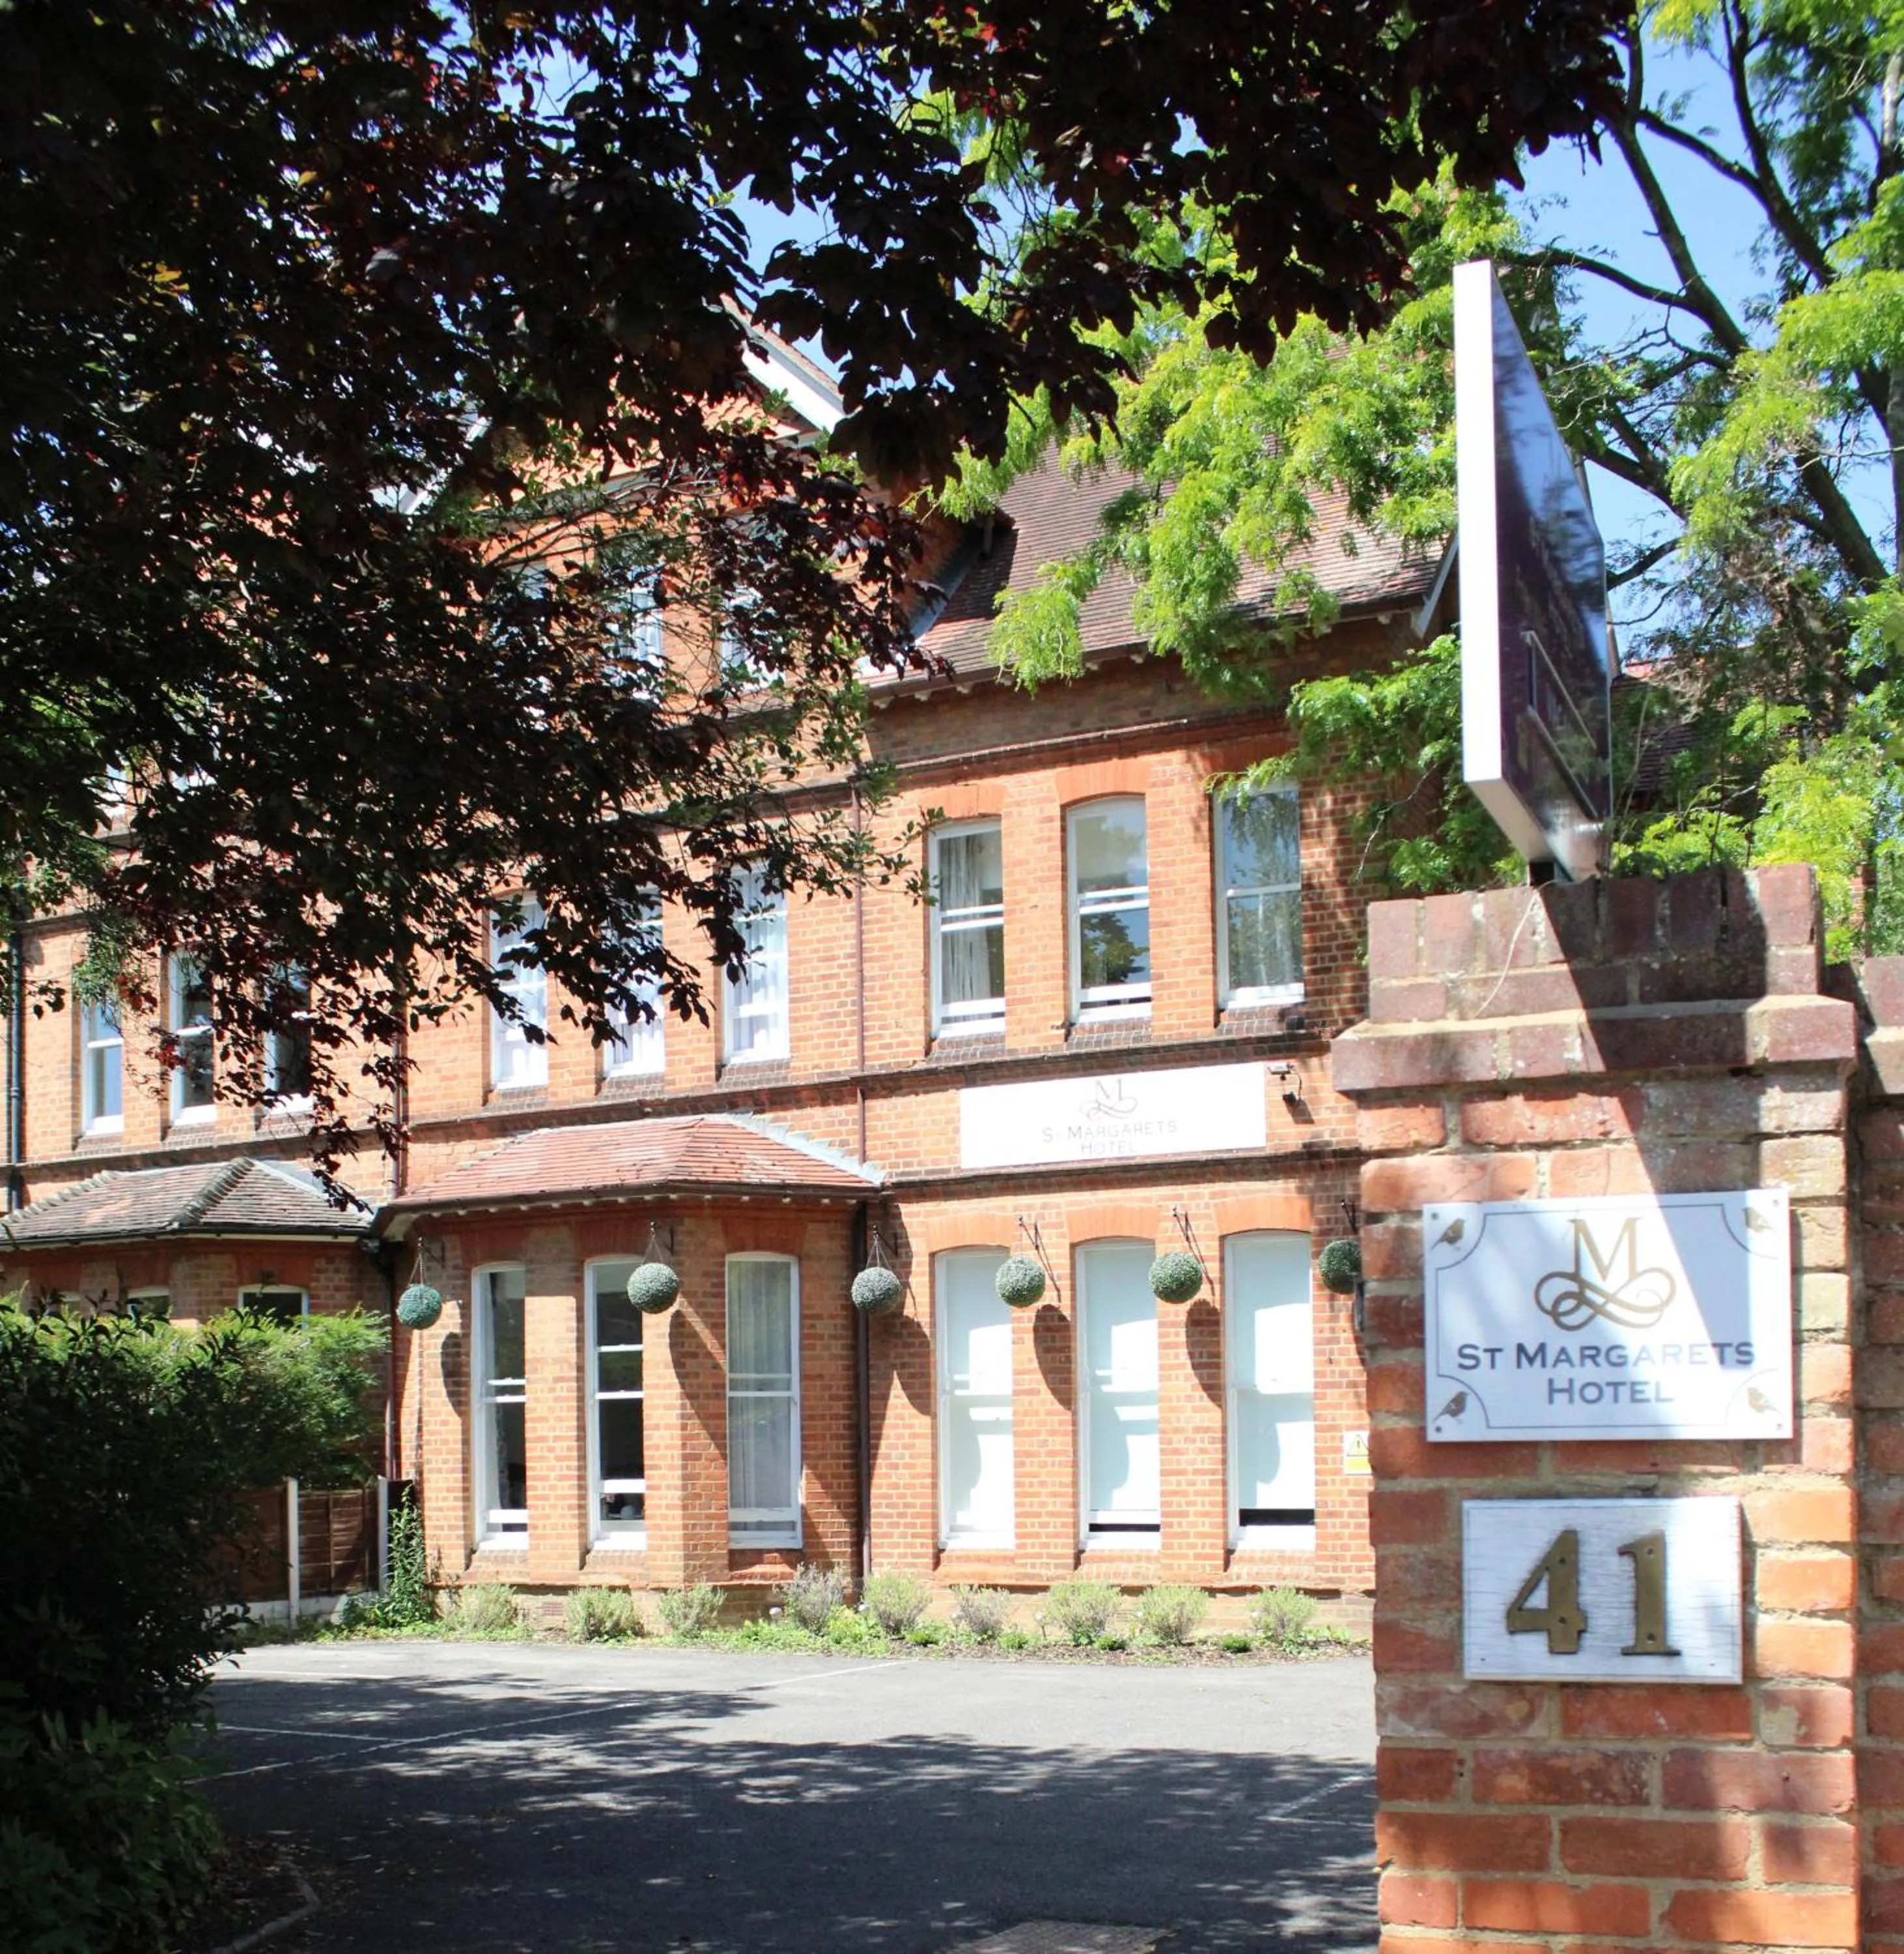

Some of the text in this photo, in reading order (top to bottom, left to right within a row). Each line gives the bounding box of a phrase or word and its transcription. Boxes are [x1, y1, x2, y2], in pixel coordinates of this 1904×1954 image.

[1042, 1119, 1177, 1144] S MARGARETS
[1080, 1140, 1139, 1157] HOTEL
[1457, 1341, 1756, 1370] ST MARGARETS
[1548, 1378, 1674, 1405] HOTEL
[1505, 1529, 1681, 1656] 41
